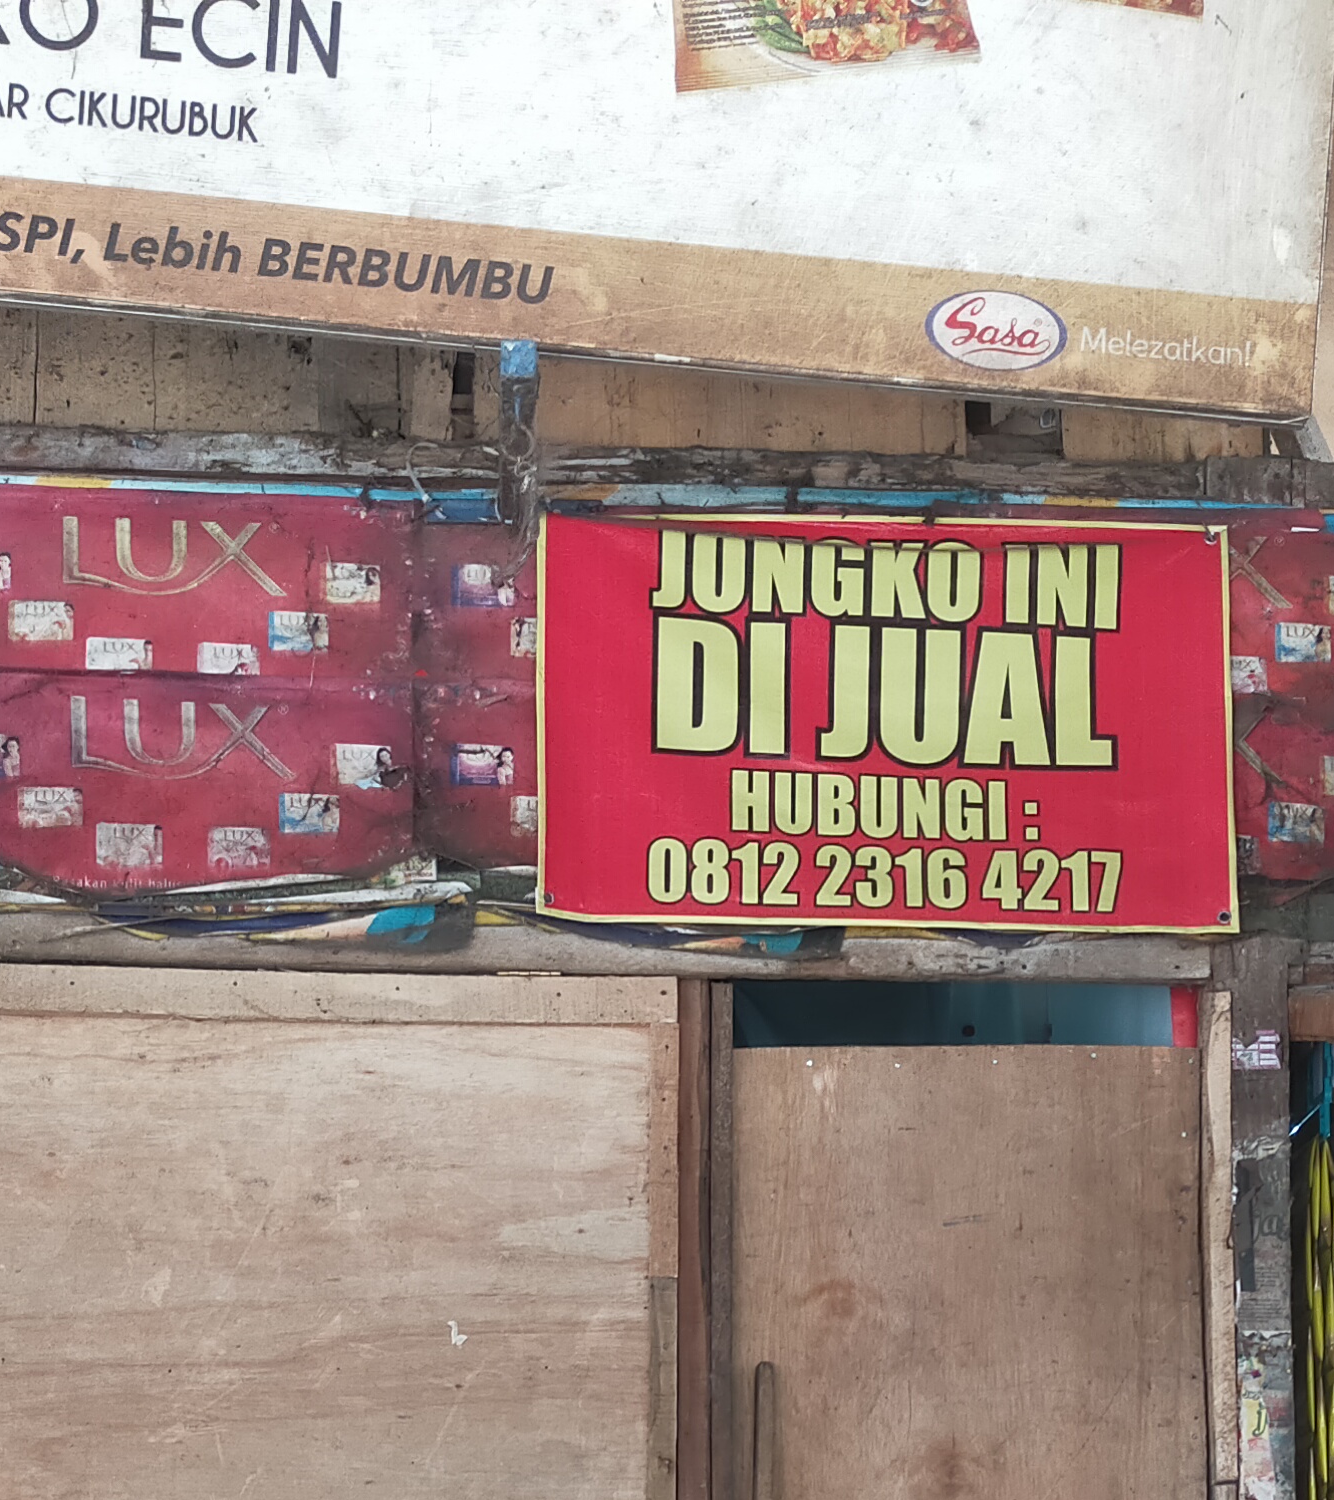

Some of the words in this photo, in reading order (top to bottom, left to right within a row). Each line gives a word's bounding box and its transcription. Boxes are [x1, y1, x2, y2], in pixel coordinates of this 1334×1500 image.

[140, 0, 342, 78] ECIN
[45, 88, 258, 143] CIKURUBUK
[103, 223, 241, 273] Lebih
[257, 239, 554, 304] BERBUMBU
[944, 296, 1051, 356] Sasa
[1079, 326, 1253, 368] Melezatkan!
[63, 516, 287, 597] LUX
[1002, 542, 1121, 632] INI
[103, 640, 138, 654] LUX
[213, 646, 244, 659] LUX
[1286, 626, 1317, 639] LUX
[652, 614, 790, 759] DI
[816, 621, 1118, 770] JUAL
[71, 696, 295, 780] LUX
[342, 749, 377, 762] LUX
[34, 789, 69, 805] LUX
[729, 768, 1010, 843] HUBUNGI
[113, 827, 148, 841] LUX
[647, 837, 802, 907] 0812
[815, 844, 969, 911] 2316
[981, 848, 1123, 914] 4217
